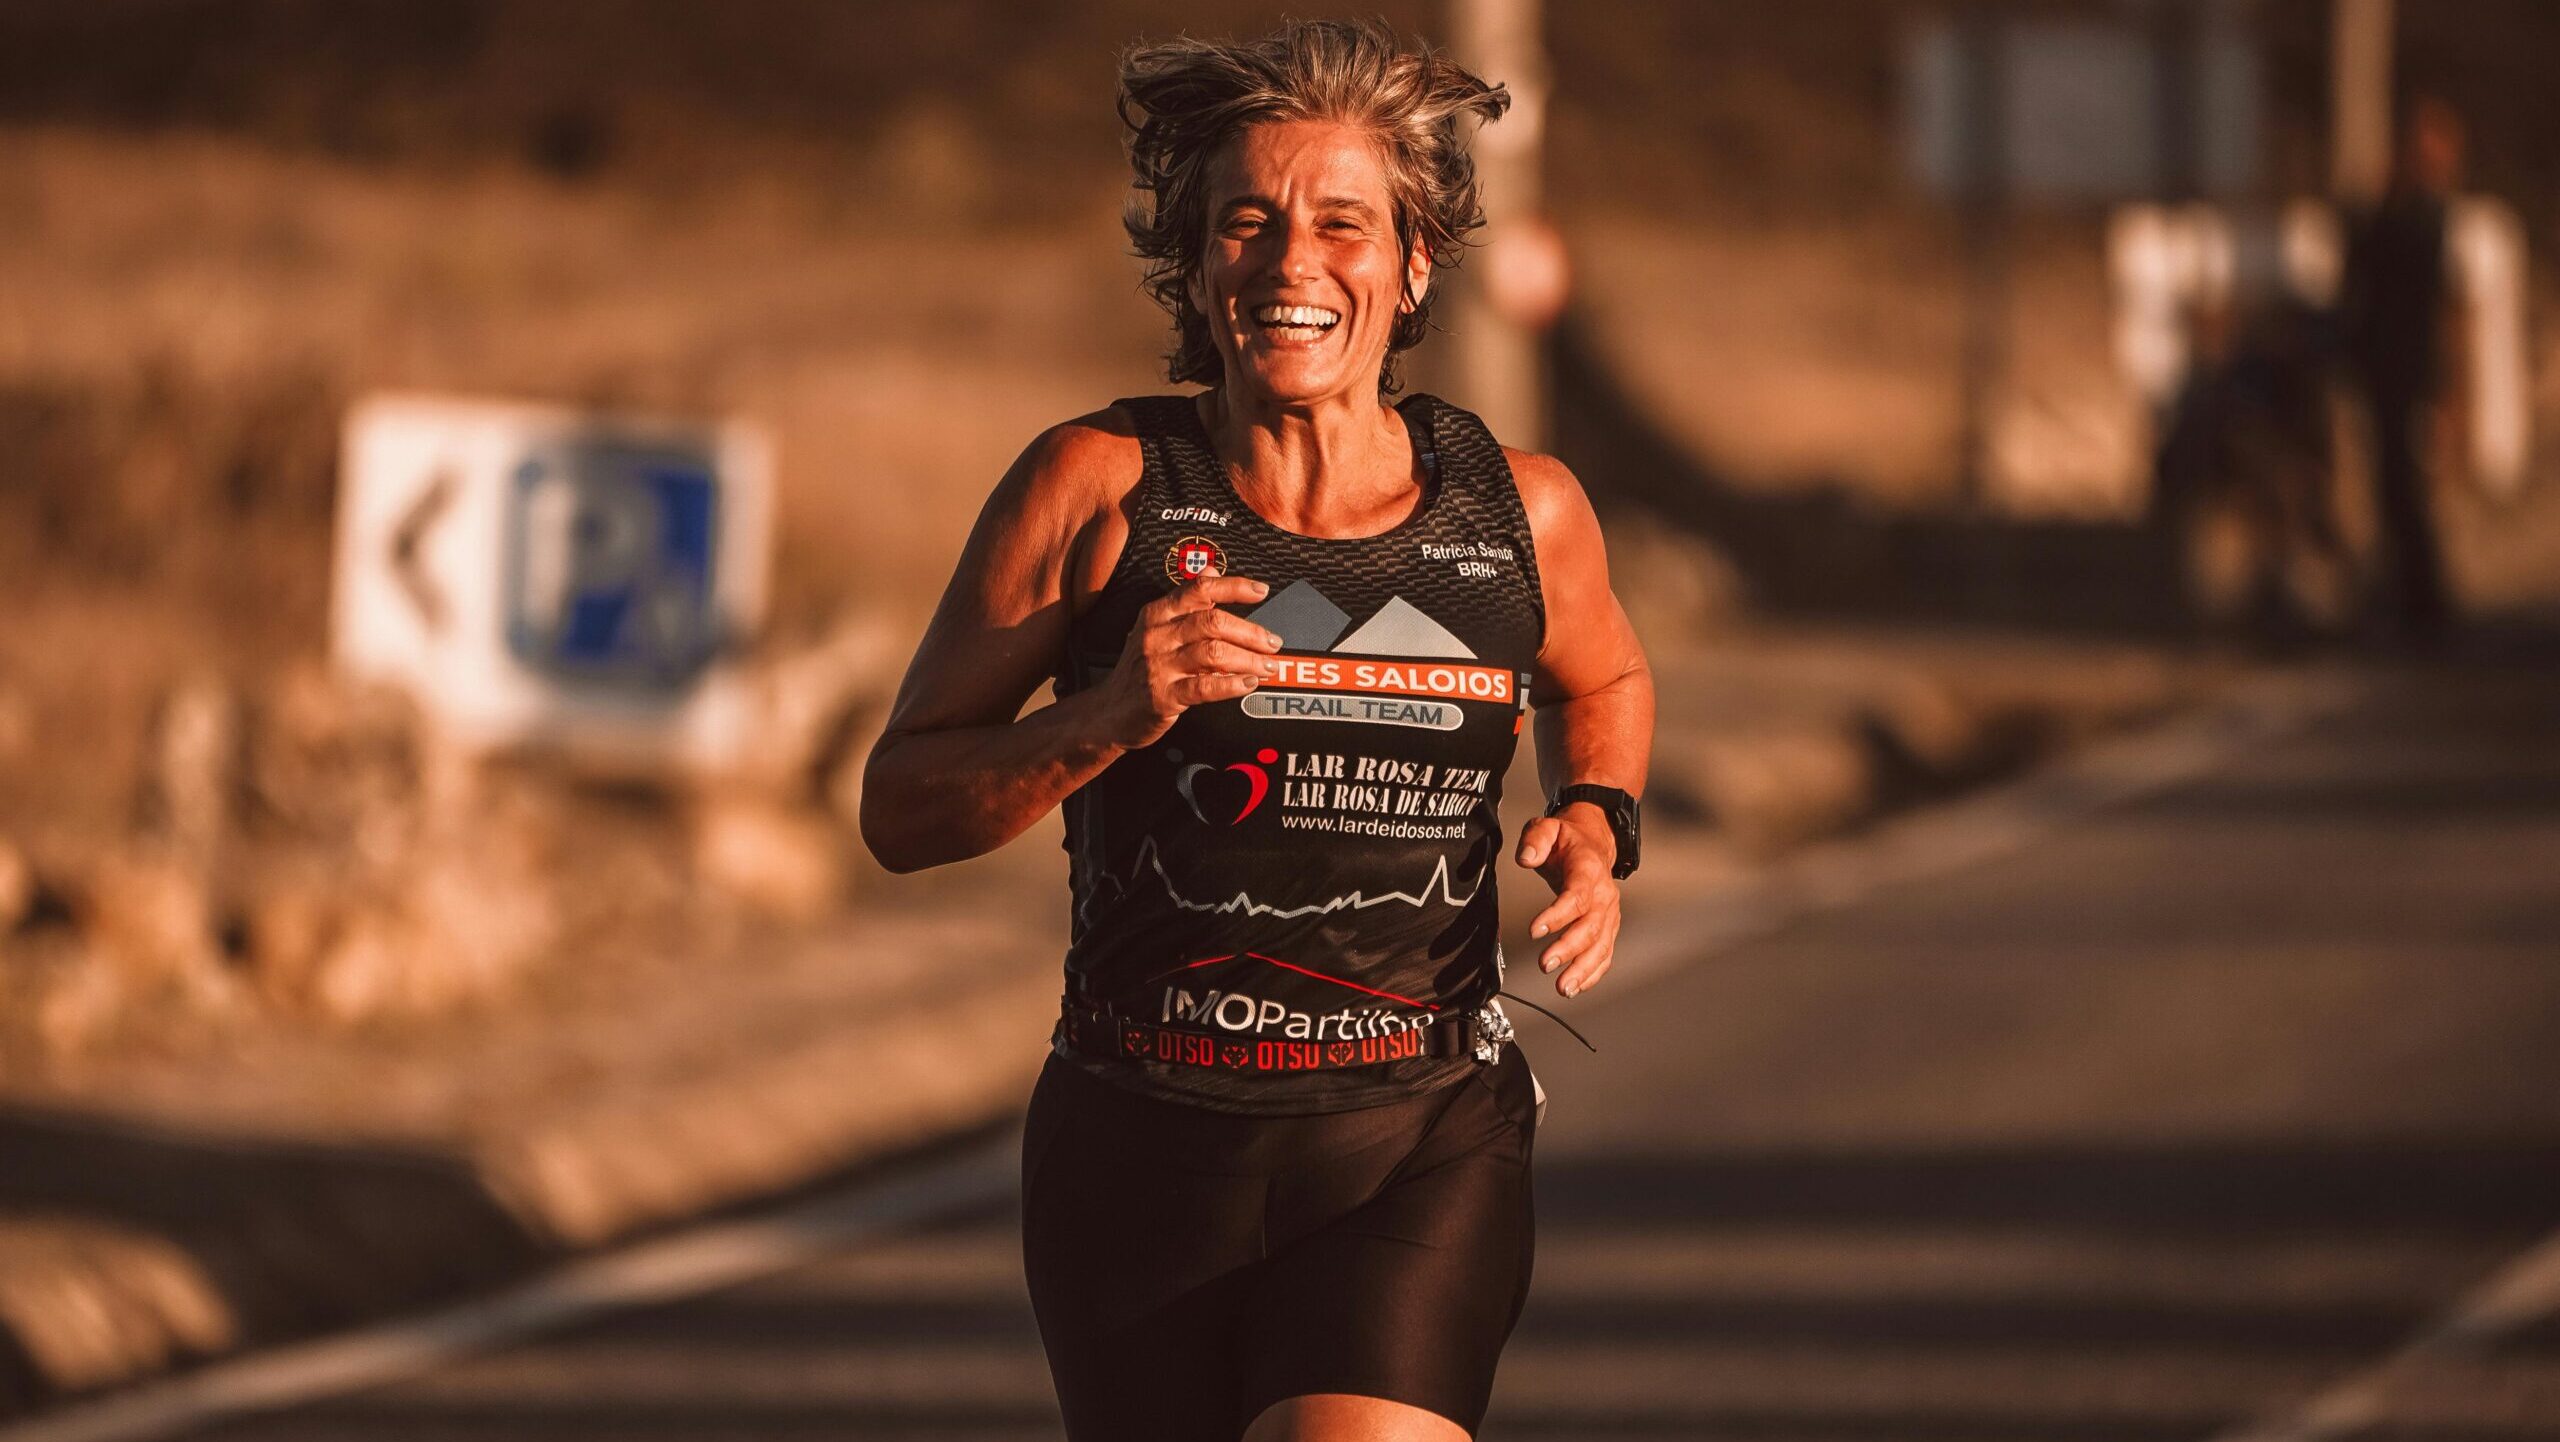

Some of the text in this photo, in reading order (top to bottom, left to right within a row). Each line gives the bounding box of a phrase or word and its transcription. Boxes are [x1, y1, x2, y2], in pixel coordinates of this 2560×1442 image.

[1421, 543, 1476, 559] Patricia
[1457, 562, 1498, 578] BRH+
[1259, 660, 1507, 698] TES SALOIOS
[1265, 697, 1443, 726] TRAIL TEAM
[1286, 753, 1490, 794] LAR ROSA TEJO
[1282, 782, 1326, 809] LAR
[1332, 784, 1389, 814] ROSA
[1395, 789, 1425, 816] DE
[1281, 815, 1466, 839] www.lardeidosos.net
[1158, 1030, 1214, 1067] OTSO
[1257, 1040, 1320, 1071] OTSO
